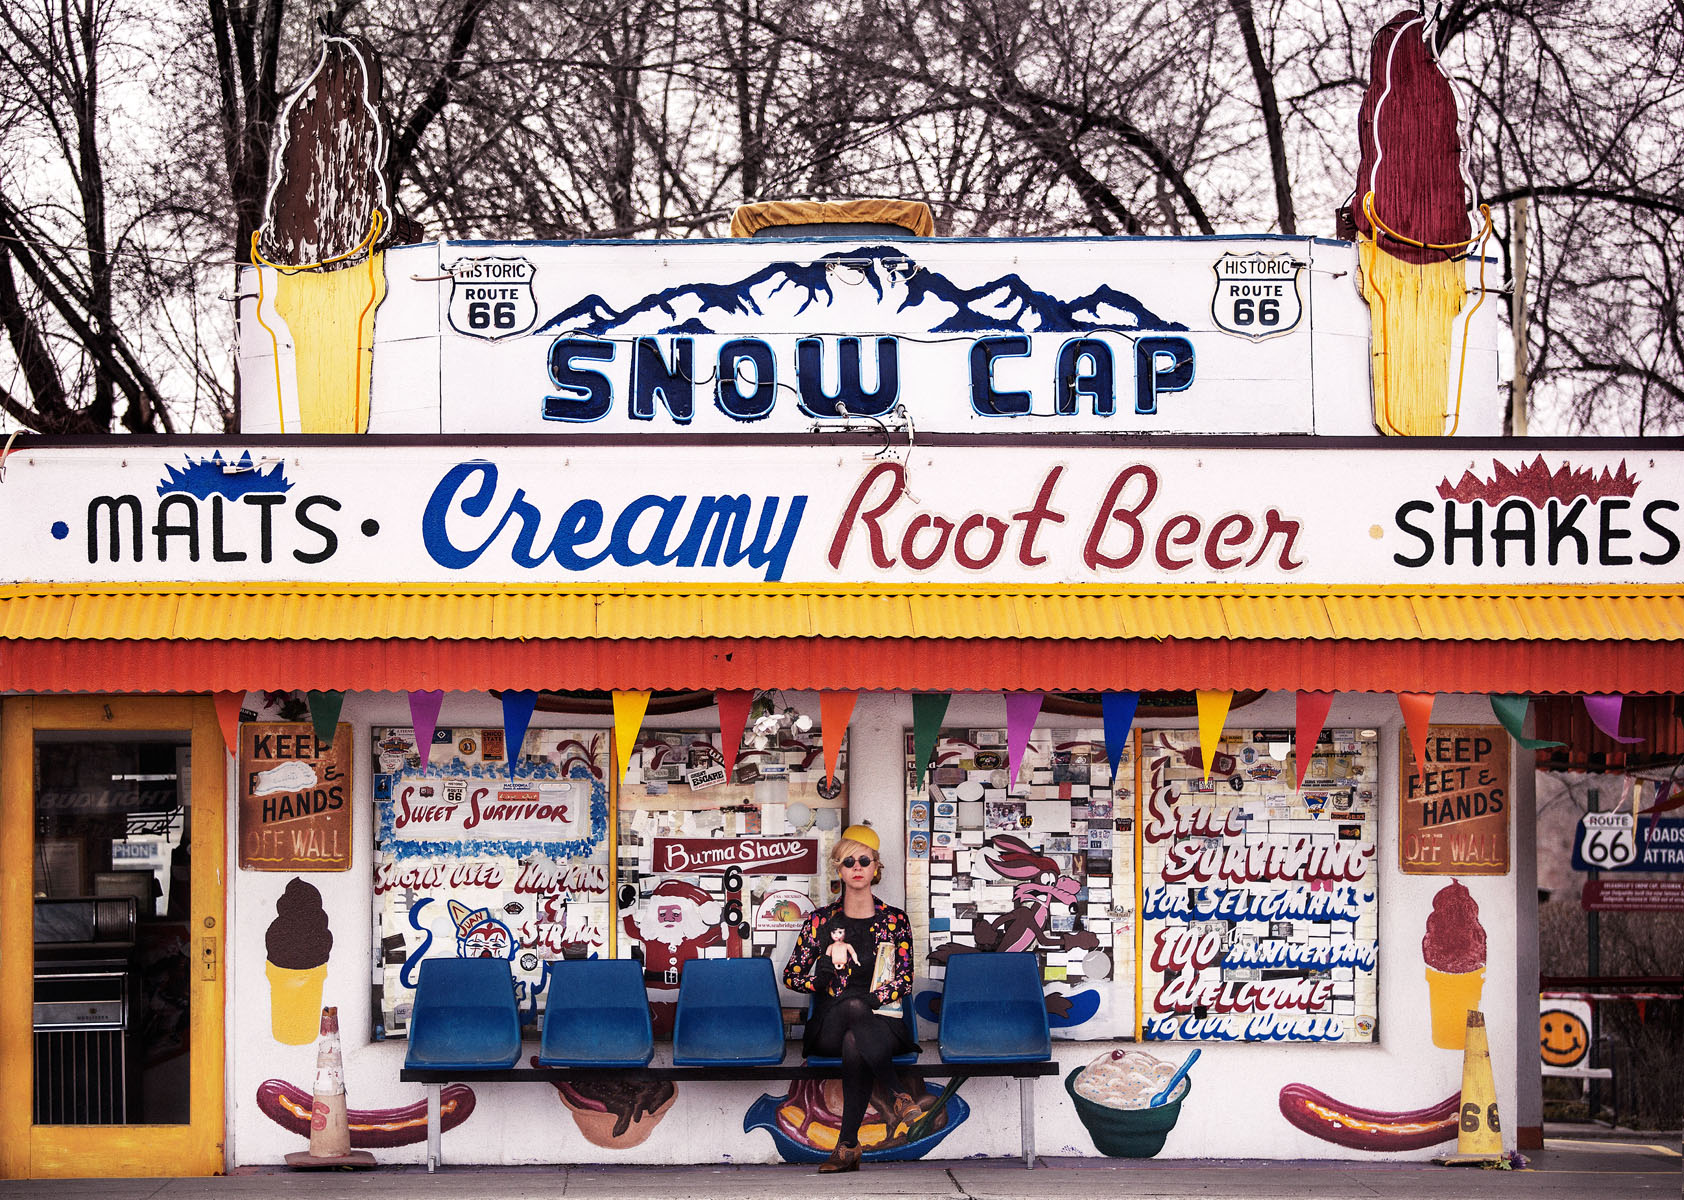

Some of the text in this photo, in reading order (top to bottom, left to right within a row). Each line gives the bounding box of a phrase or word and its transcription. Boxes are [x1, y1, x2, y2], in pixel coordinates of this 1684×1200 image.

[459, 263, 526, 279] HISTORIC
[1225, 260, 1291, 275] HISTORIC
[465, 288, 519, 301] ROUTE
[1229, 285, 1283, 297] ROUTE
[468, 302, 516, 329] 66
[1233, 299, 1280, 326] 66
[541, 335, 1197, 425] SNOW CAP
[87, 493, 339, 564] MALTS
[421, 459, 808, 582] Creamy
[827, 461, 1307, 572] Root Beer
[1394, 497, 1681, 569] SHAKES
[692, 771, 724, 786] ESCAPE
[1408, 767, 1471, 799] FEET
[263, 786, 344, 823] HANDS
[396, 786, 572, 830] SWEET SURVIVOR
[447, 793, 462, 801] 66
[1423, 789, 1504, 826] HANDS
[1589, 816, 1629, 826] ROUTE
[113, 844, 157, 858] PHONE
[291, 830, 344, 857] WALL
[664, 840, 805, 872] Burma Shave
[1405, 833, 1504, 862] OFF WALL
[1588, 831, 1630, 862] 66
[1161, 838, 1375, 884] SURVIVING
[450, 863, 504, 890] USED
[724, 865, 743, 893] 6
[724, 899, 743, 926] 6
[1143, 886, 1195, 922] FOR
[458, 912, 485, 938] JUAN
[1155, 967, 1335, 1014] WELCOME
[1244, 1013, 1344, 1042] WORLD
[1461, 1103, 1501, 1133] 66
